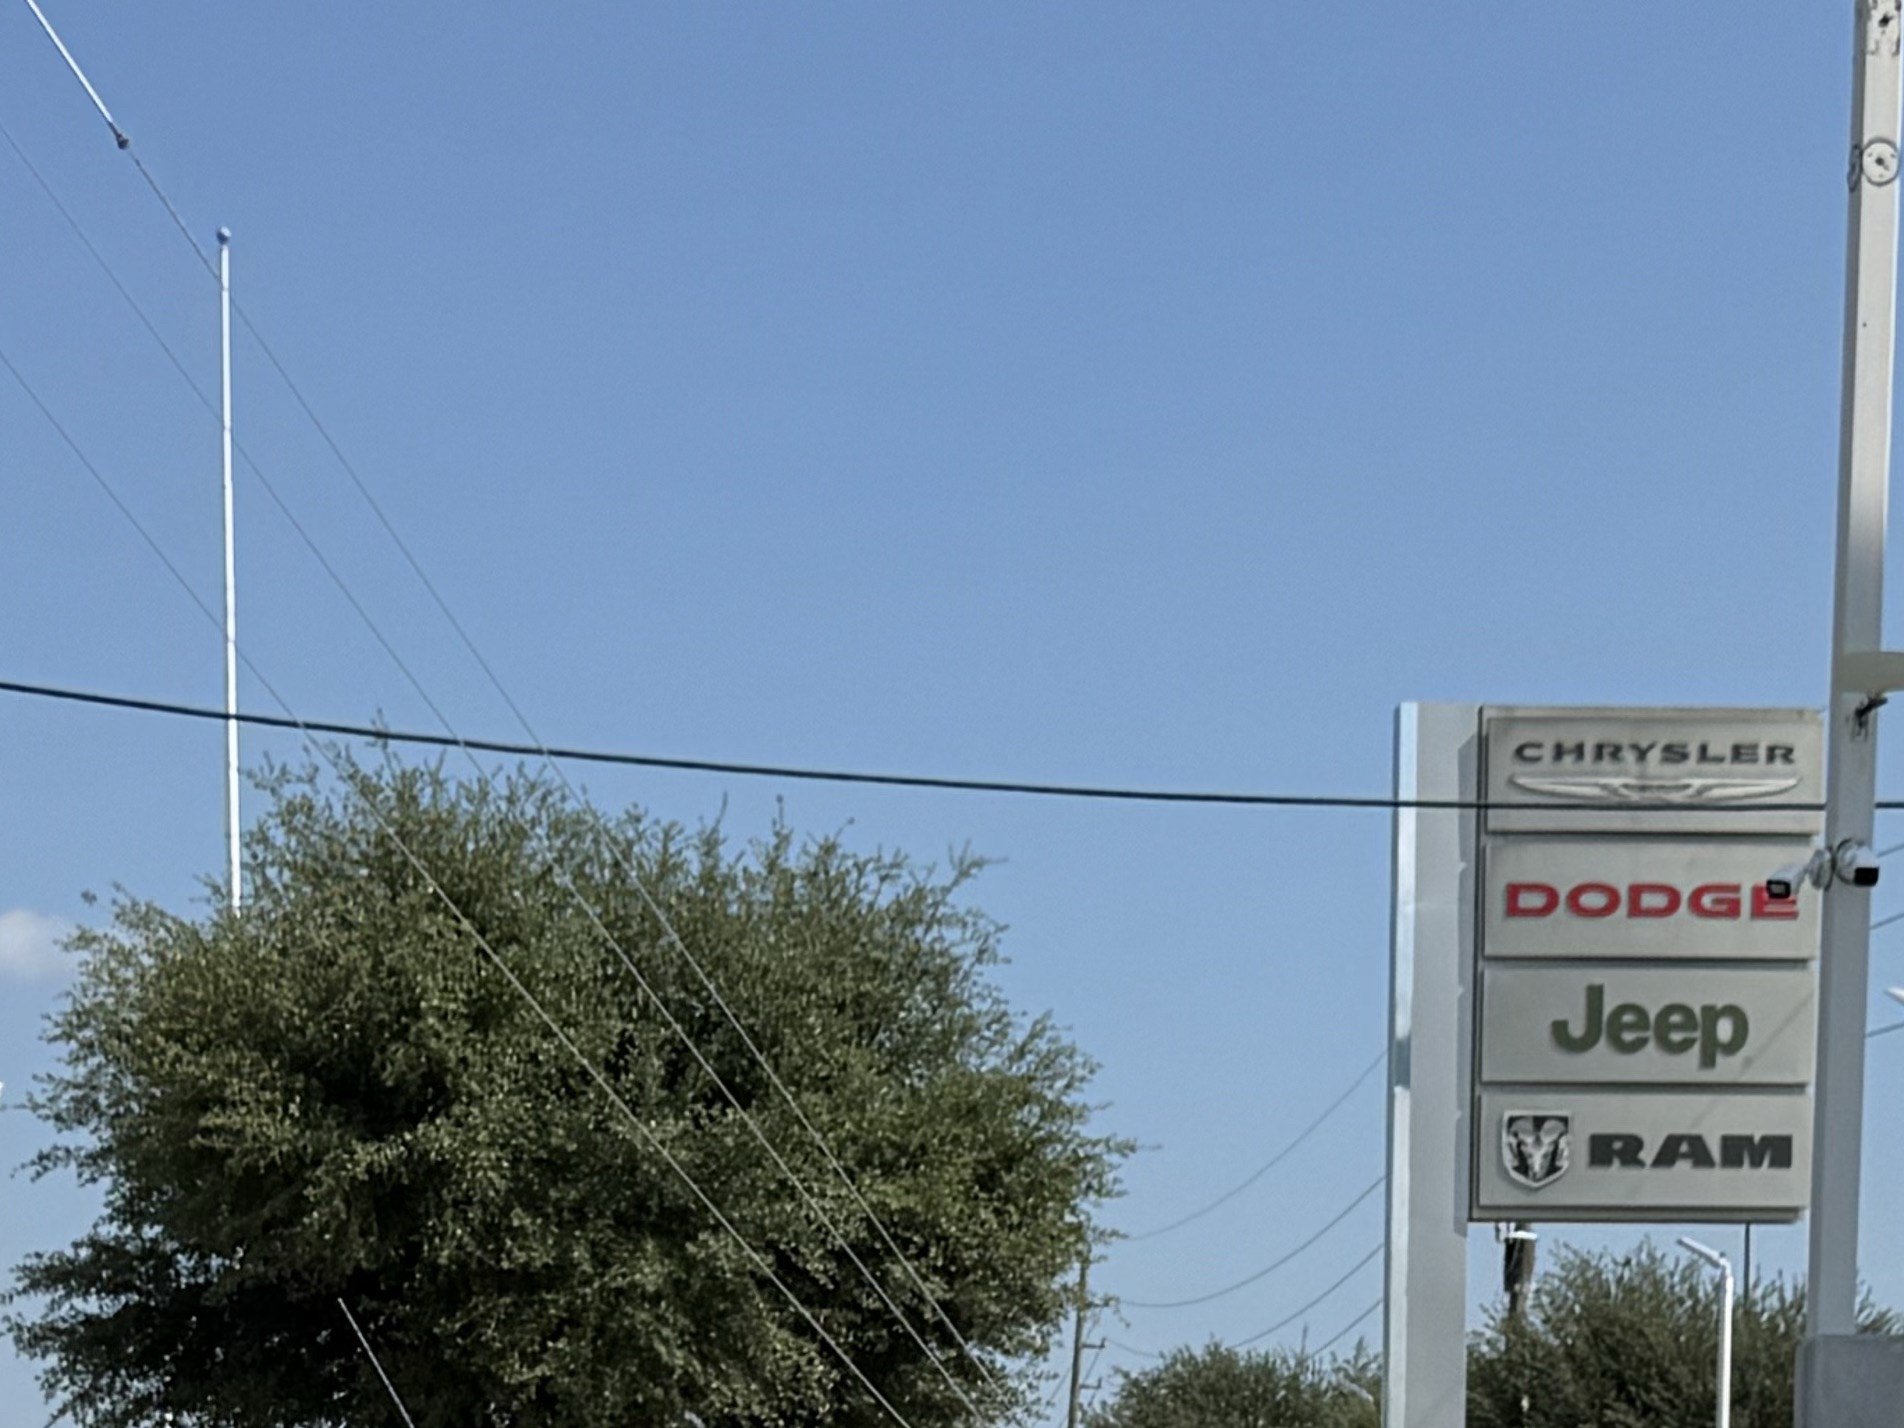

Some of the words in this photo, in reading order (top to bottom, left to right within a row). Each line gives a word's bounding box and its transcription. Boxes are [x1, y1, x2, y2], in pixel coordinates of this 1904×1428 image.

[1512, 740, 1797, 766] CHRYSLER
[1504, 881, 1800, 920] DODGE
[1551, 984, 1750, 1069] Jeep
[1588, 1133, 1794, 1170] RAM
